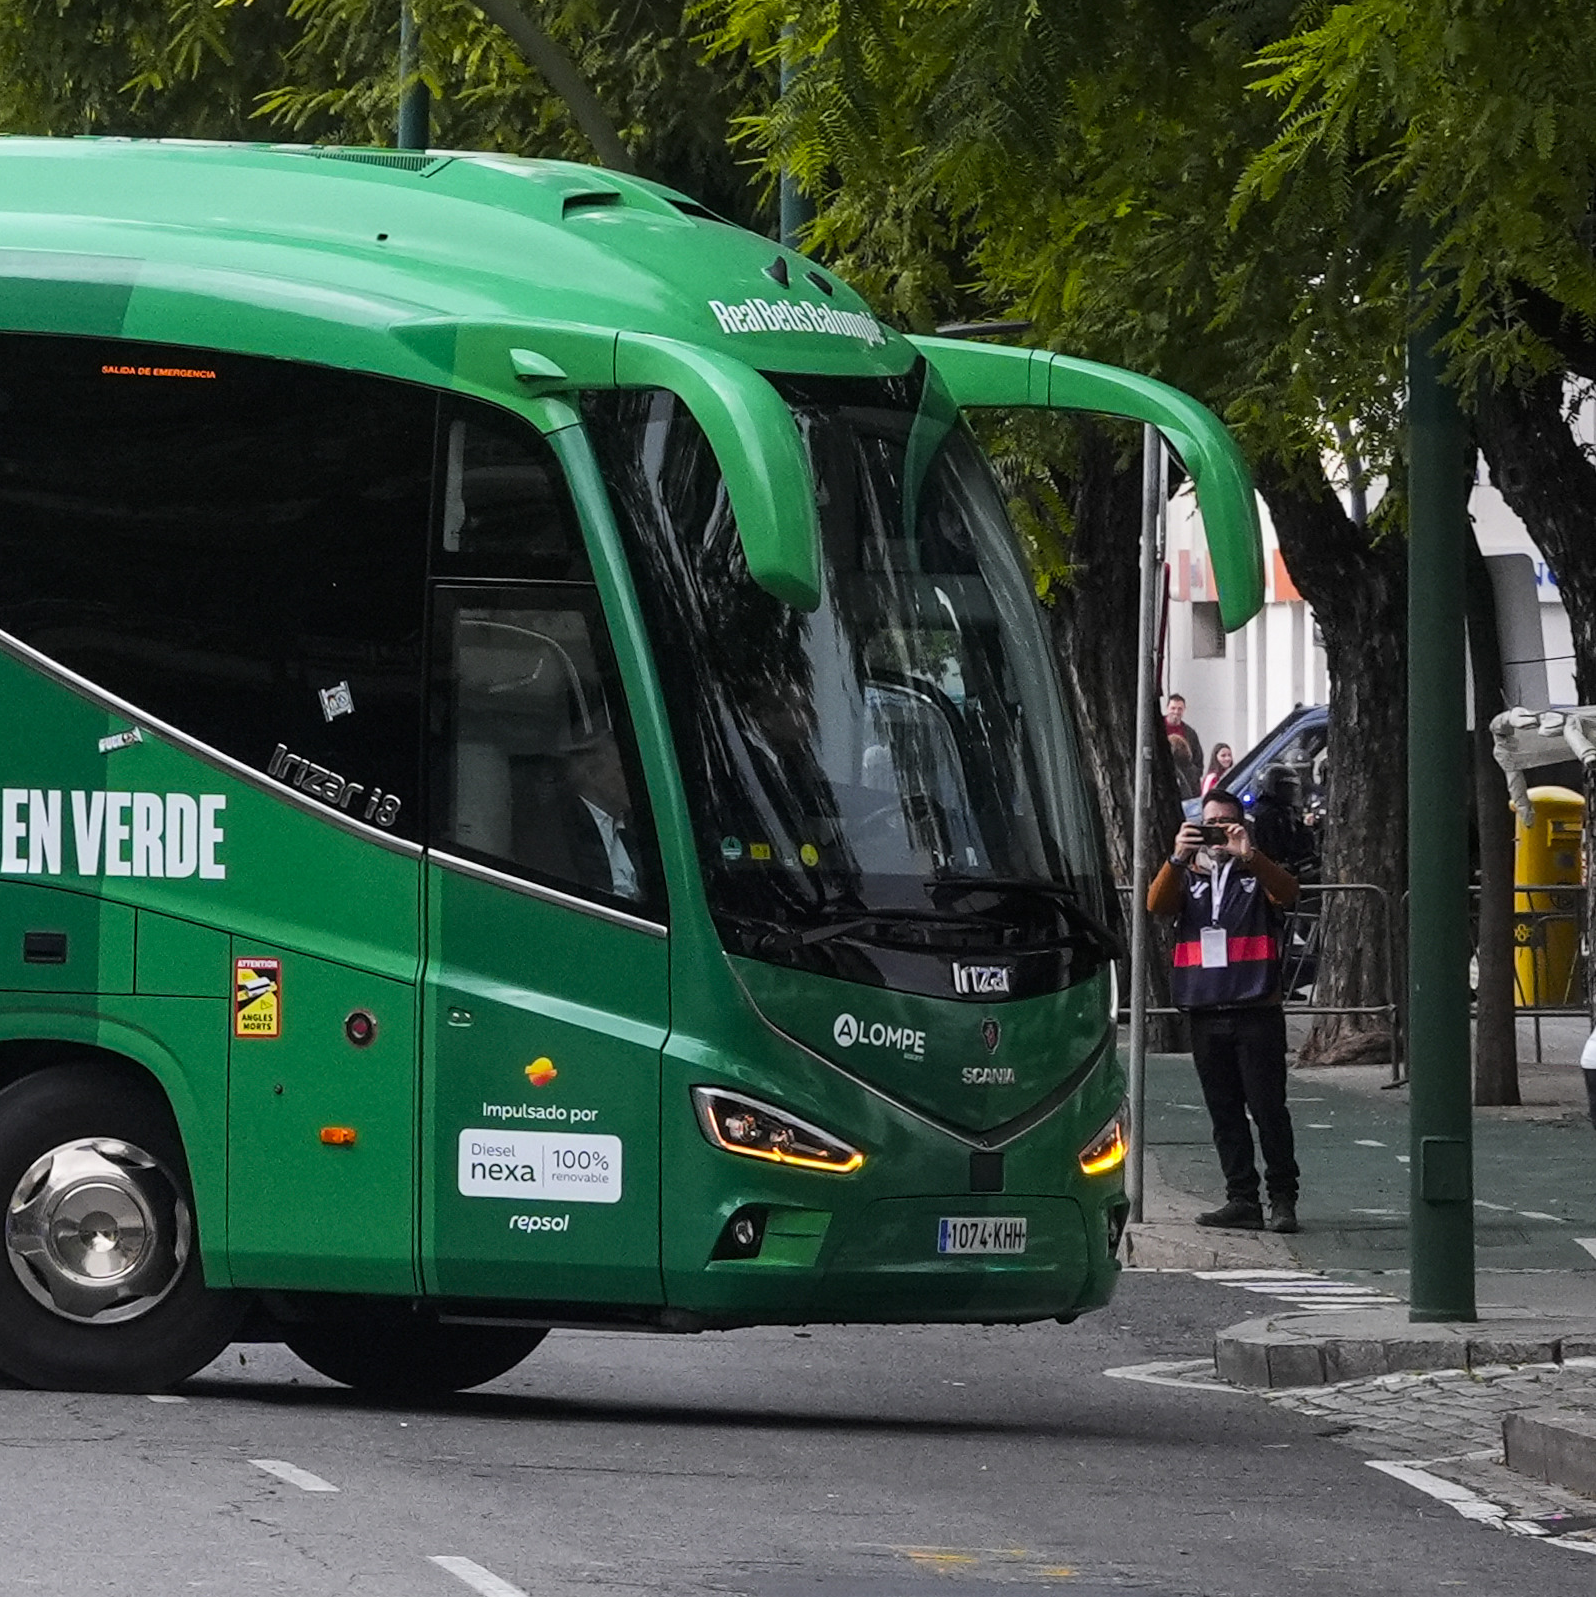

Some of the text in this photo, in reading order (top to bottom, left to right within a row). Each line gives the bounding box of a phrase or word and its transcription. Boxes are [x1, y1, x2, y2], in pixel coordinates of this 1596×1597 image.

[101, 365, 217, 379] SALIDA DE EMERGENCIA
[267, 742, 402, 827] Irizar i8
[0, 788, 62, 875] EN
[70, 790, 227, 880] VERDE
[241, 1013, 274, 1022] ANGLES
[242, 1022, 272, 1031] MORTS
[961, 1067, 1016, 1085] SCANIA
[482, 1102, 599, 1124] Impulsado por
[470, 1142, 516, 1158] Diesel
[552, 1150, 610, 1171] 100%
[470, 1161, 537, 1183] nexa
[551, 1172, 610, 1184] renovable
[509, 1214, 570, 1234] repsol
